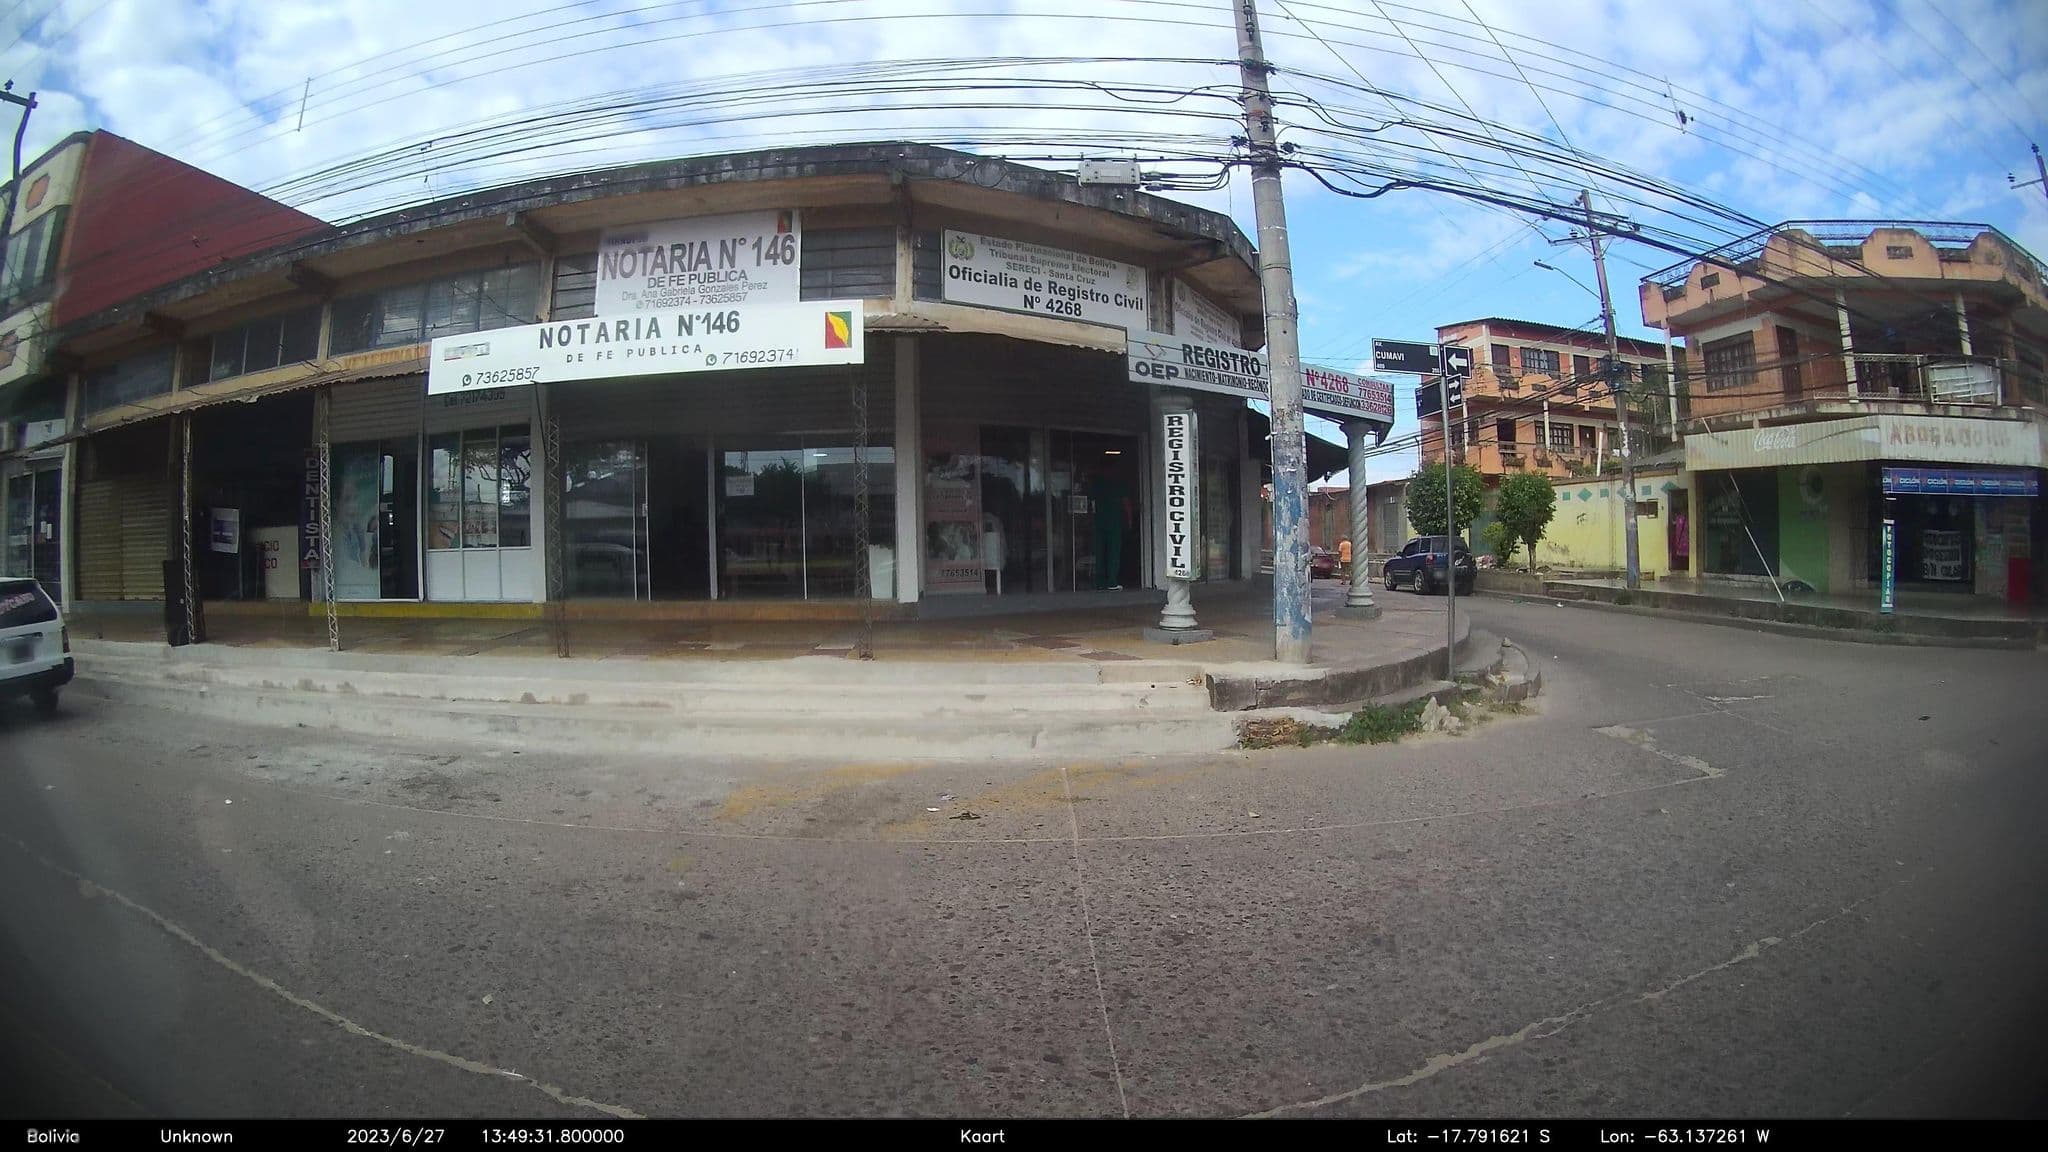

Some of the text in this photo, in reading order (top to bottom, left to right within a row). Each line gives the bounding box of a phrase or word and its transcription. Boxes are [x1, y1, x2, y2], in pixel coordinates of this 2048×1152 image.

[602, 240, 713, 281] NOTARIA
[752, 234, 796, 268] 146
[979, 236, 1013, 250] Estado
[1076, 252, 1087, 263] de
[988, 248, 1110, 279] Tribunal Supremo Electoral
[1005, 261, 1041, 276] SERECI
[1048, 268, 1074, 282] Santa
[1076, 273, 1097, 286] Cruz
[647, 269, 748, 289] DE FE PUBLICA
[948, 264, 1144, 311] Oficialia de Registro Civil
[644, 296, 692, 310] 71692374
[699, 292, 748, 305] 73625857
[1045, 298, 1083, 317] 4268
[538, 315, 662, 350] NOTARIA
[566, 344, 703, 364] DE FE PUBLICA
[721, 349, 794, 366] 71692374
[1375, 351, 1405, 361] CUMAVI
[475, 366, 540, 386] 73625857
[1135, 361, 1180, 380] OEP
[1182, 343, 1261, 376] REGISTRO
[1320, 370, 1350, 394] 4268
[304, 457, 320, 561] DENTISTA
